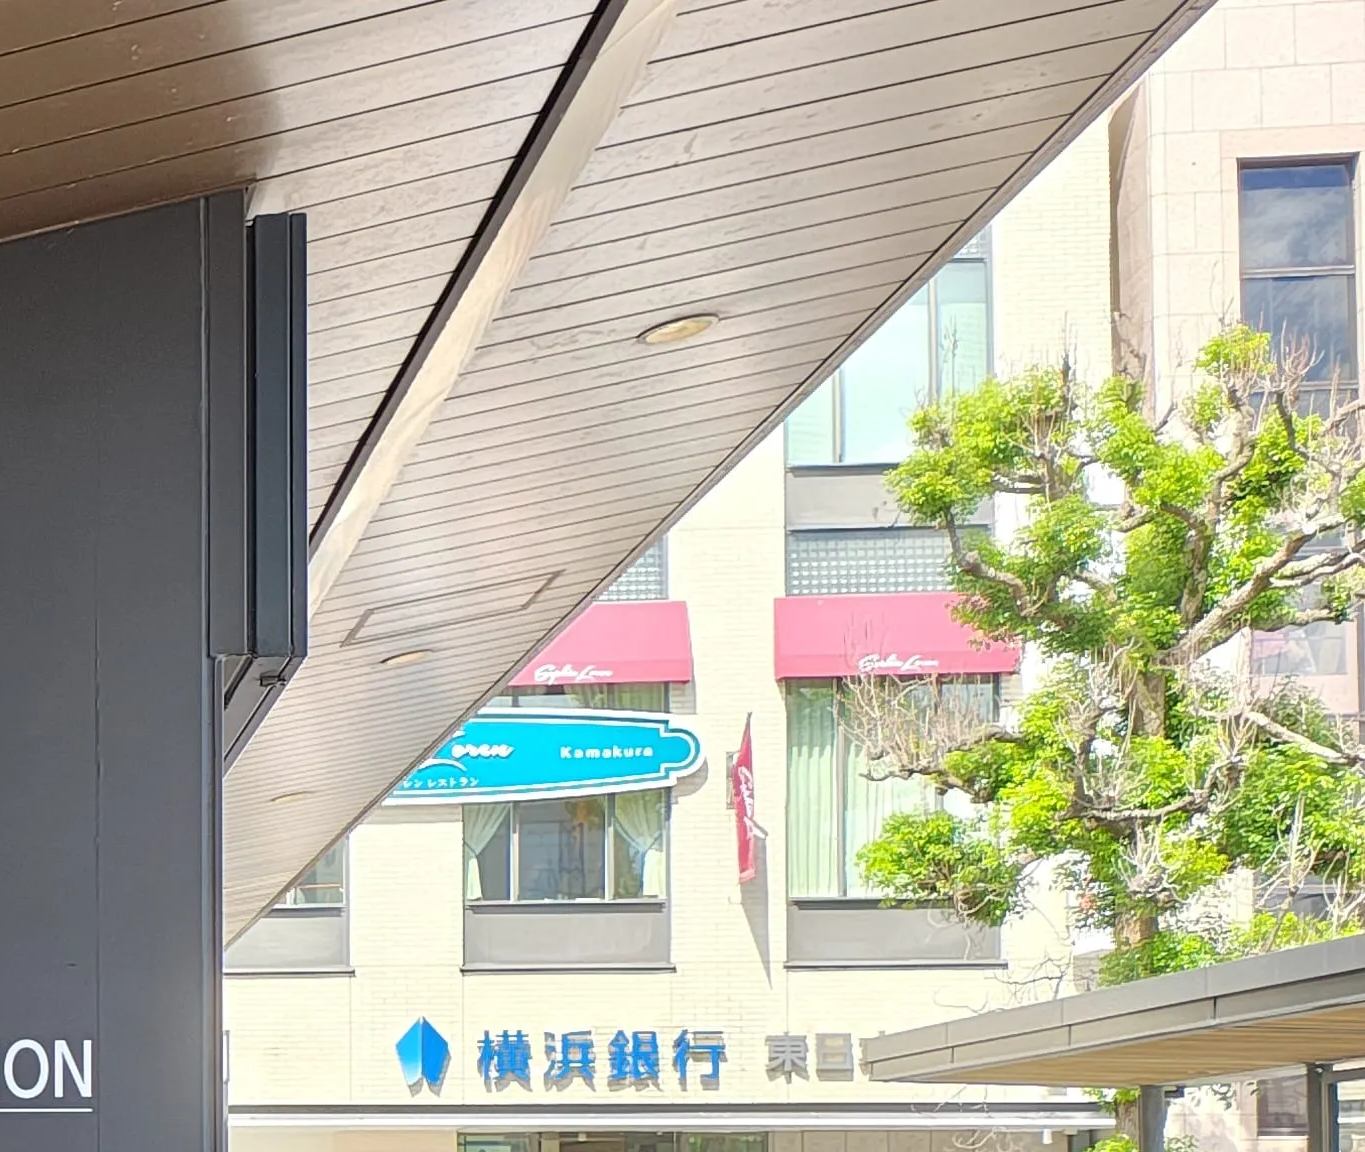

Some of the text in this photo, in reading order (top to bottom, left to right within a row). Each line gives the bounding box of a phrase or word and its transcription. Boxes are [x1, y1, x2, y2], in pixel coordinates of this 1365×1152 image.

[560, 745, 653, 759] Kamakura
[428, 776, 479, 789] レストラン
[477, 1030, 872, 1082] 横浜銀行 東日
